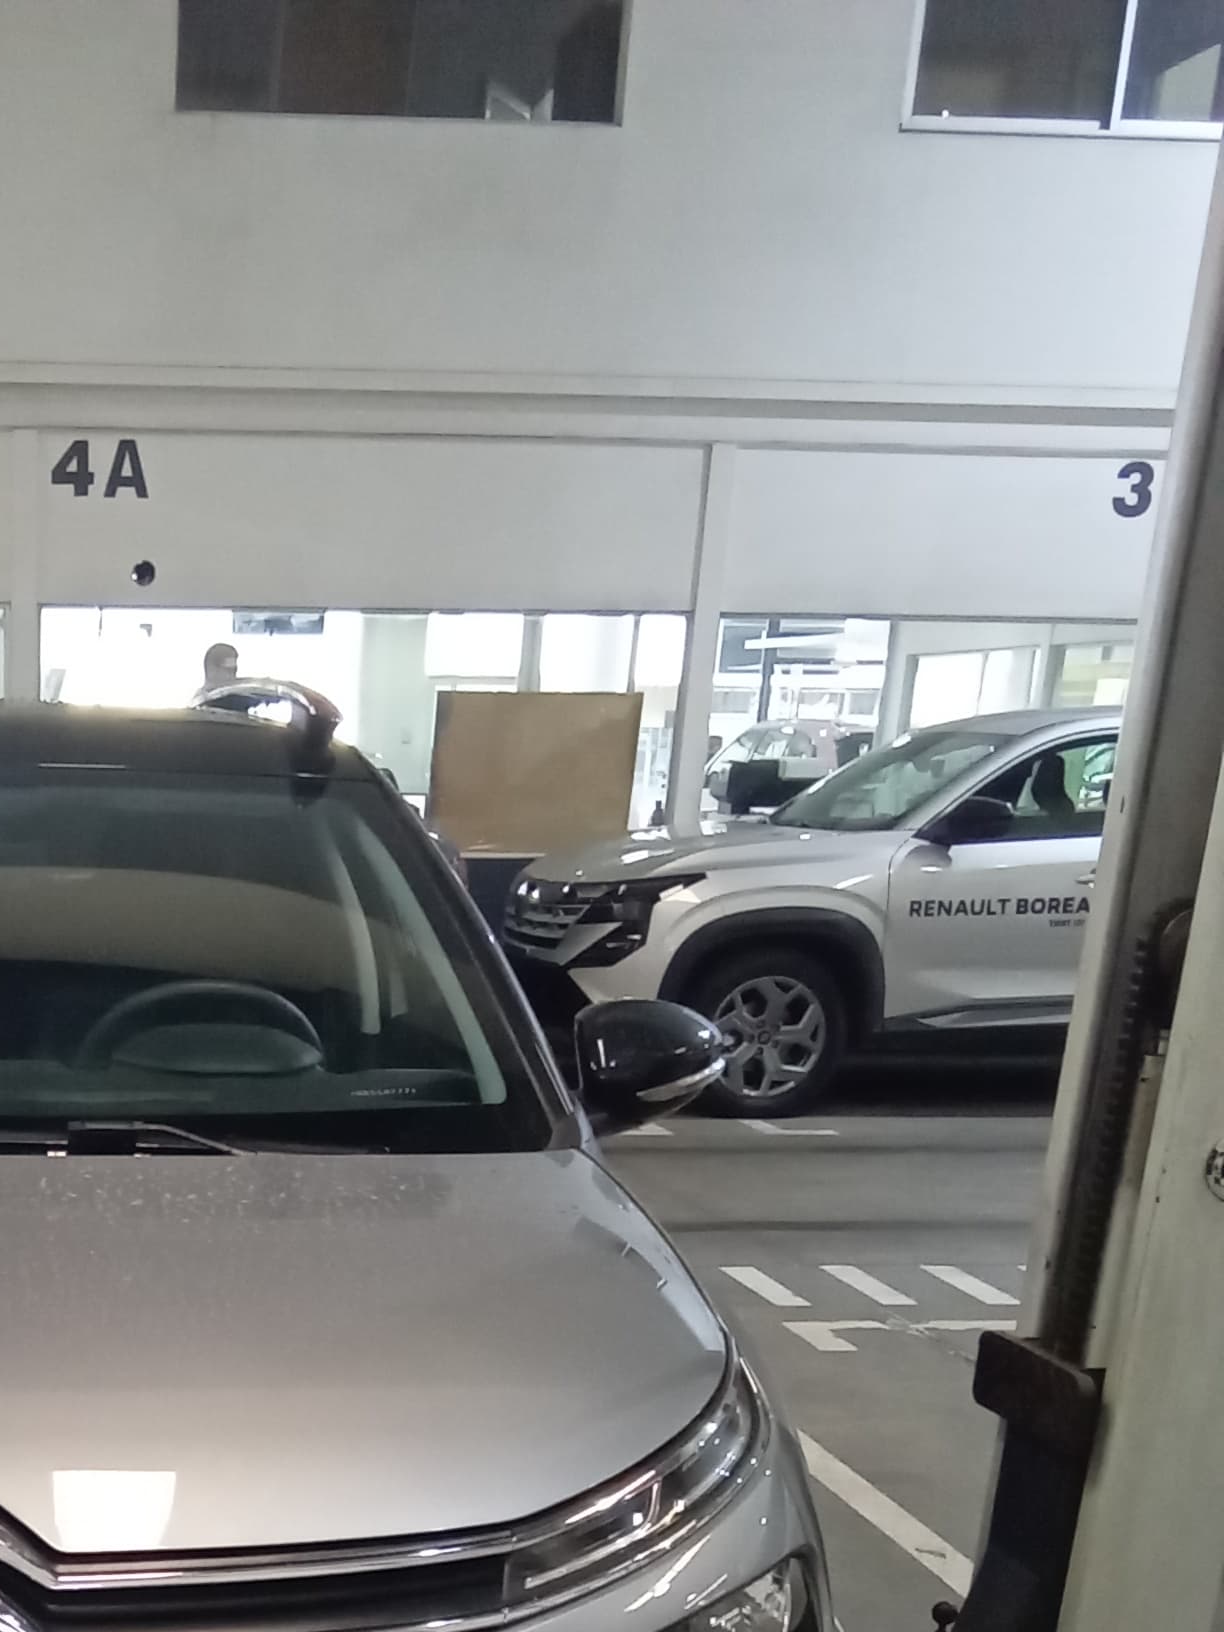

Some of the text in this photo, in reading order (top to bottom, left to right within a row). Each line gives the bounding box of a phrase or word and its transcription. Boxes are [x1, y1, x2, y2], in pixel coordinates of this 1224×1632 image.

[51, 439, 149, 499] 4A
[1112, 461, 1154, 518] 3
[909, 897, 1090, 917] RENAULT BOREA
